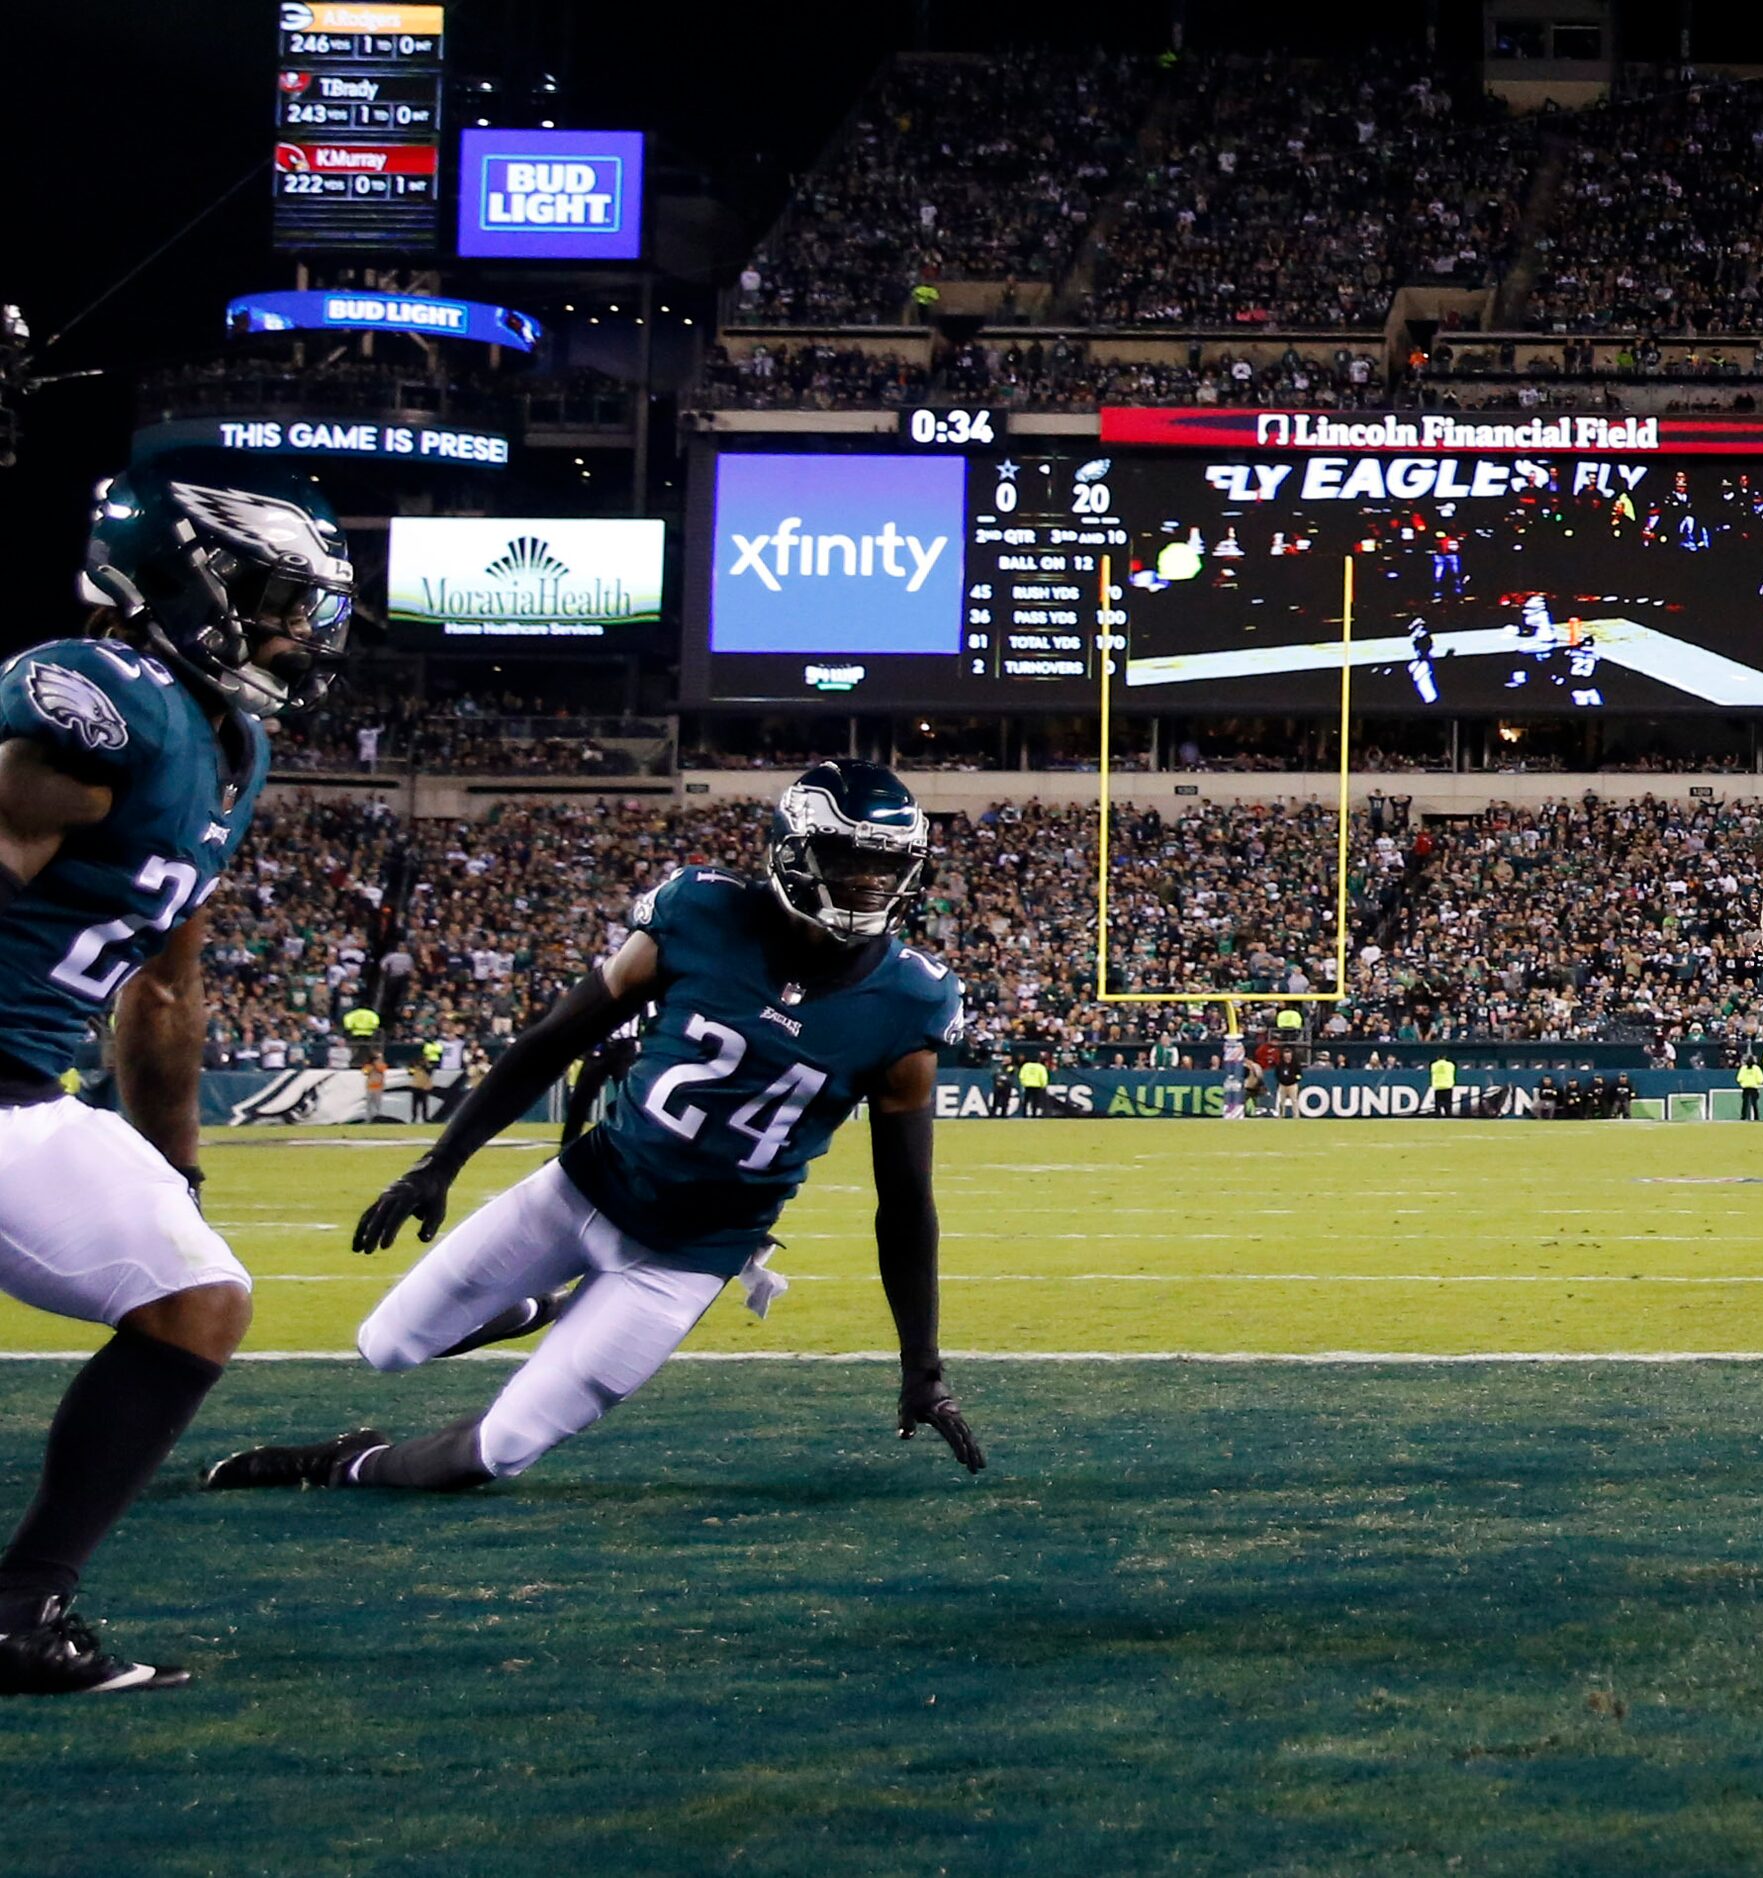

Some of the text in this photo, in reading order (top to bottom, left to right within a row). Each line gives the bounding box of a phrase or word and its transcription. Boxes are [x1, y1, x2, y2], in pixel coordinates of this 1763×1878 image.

[290, 33, 330, 53] 246
[363, 35, 373, 53] 1
[399, 36, 415, 54] 0
[287, 104, 327, 123] 243
[360, 105, 370, 123] 1
[396, 106, 411, 124] 0
[284, 174, 323, 193] 222
[355, 175, 371, 194] 0
[396, 176, 406, 194] 1
[507, 163, 596, 193] BUD
[489, 192, 611, 224] LIGHT
[327, 299, 463, 328] BUD LIGHT
[911, 409, 995, 443] 0:34
[1293, 413, 1659, 449] Lincoln Financial Field
[220, 422, 509, 464] THIS GAME IS PRESE
[1205, 457, 1648, 501] FLY EAGLES FLY
[995, 481, 1111, 514] 0 20
[1003, 529, 1037, 546] QTR
[1107, 529, 1128, 545] 10
[729, 516, 949, 593] xfinity
[998, 555, 1094, 571] BALL ON 12
[421, 576, 634, 617] MoraviaHealth
[969, 584, 992, 599] 45
[1051, 586, 1081, 600] YDS
[1049, 611, 1078, 625] YDS
[1008, 635, 1051, 650] TOTAL
[1052, 636, 1082, 650] YDS
[972, 658, 986, 675] 2
[1004, 660, 1085, 675] TURNOVERS
[645, 1012, 829, 1170] 24
[1107, 1085, 1256, 1117] AUTIS
